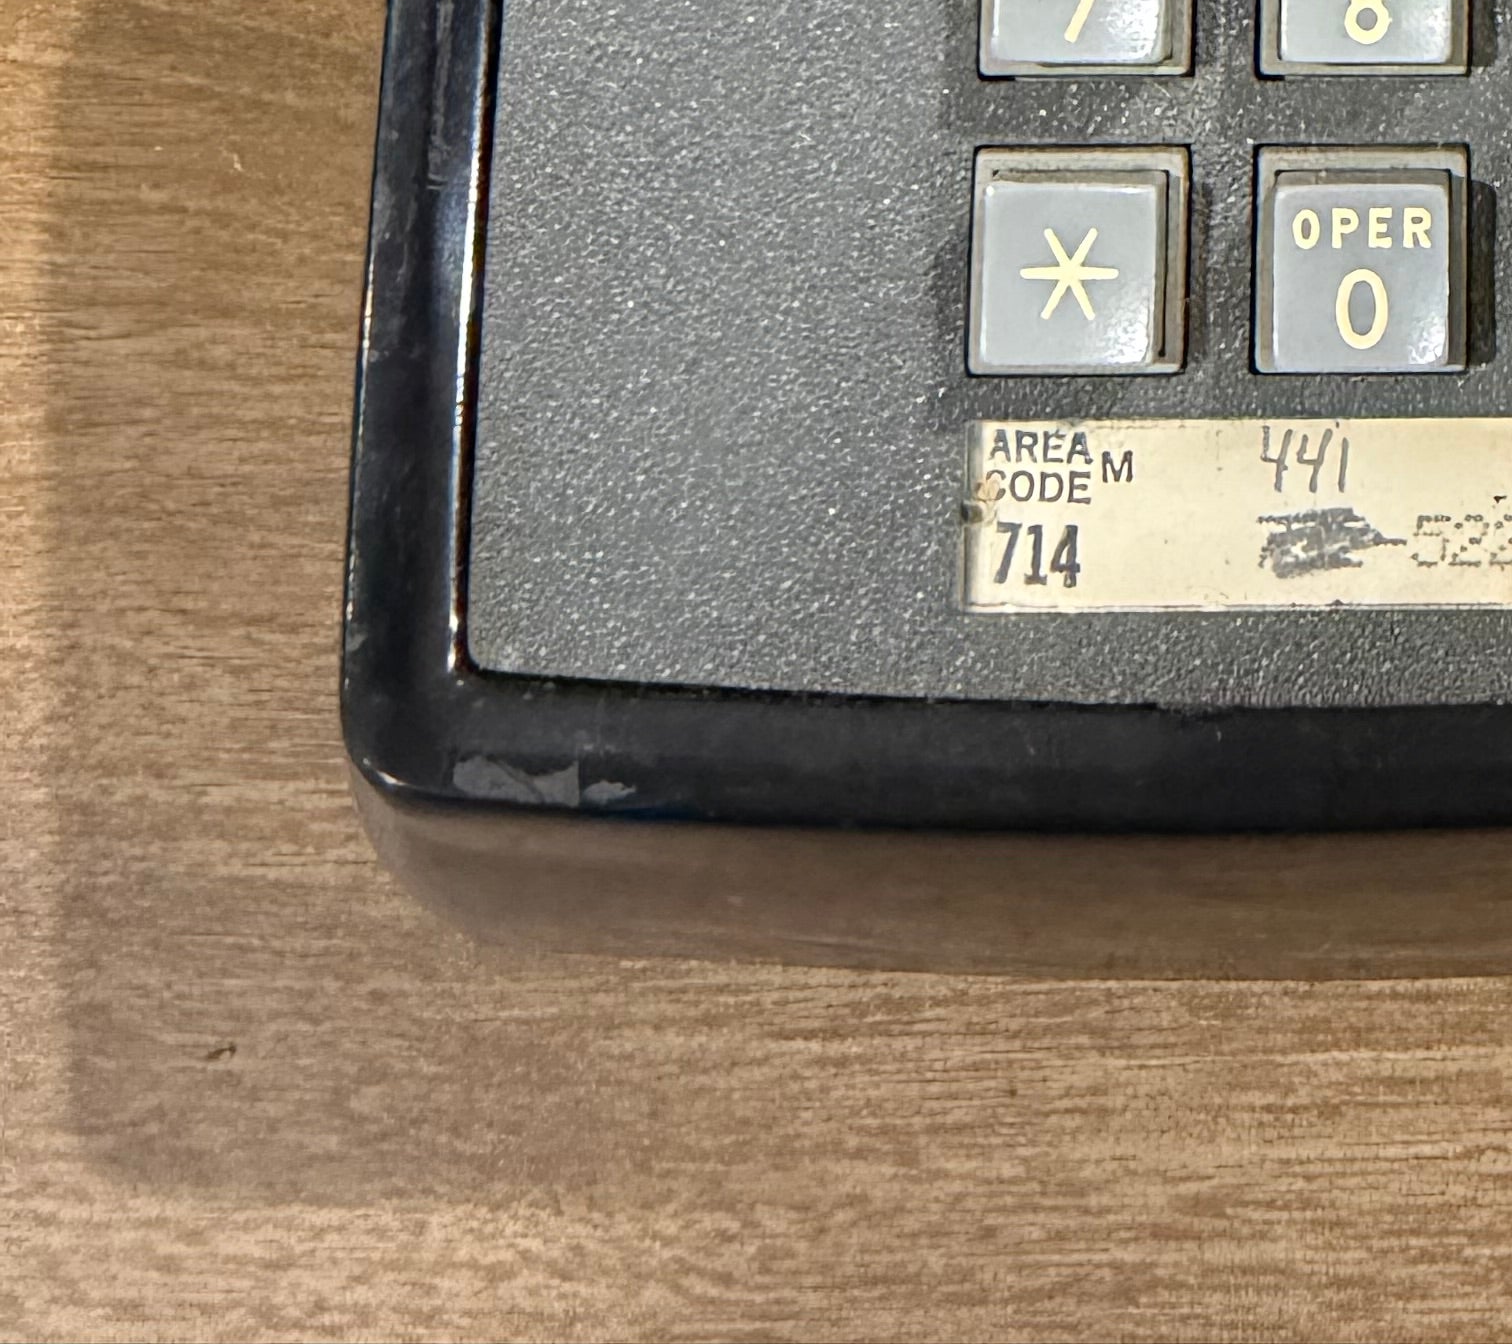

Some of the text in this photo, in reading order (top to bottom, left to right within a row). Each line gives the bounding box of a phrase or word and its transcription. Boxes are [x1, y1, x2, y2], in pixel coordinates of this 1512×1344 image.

[1292, 206, 1433, 251] OPER
[1334, 267, 1389, 350] 0
[989, 428, 1094, 465] AREA
[1101, 449, 1134, 484] M
[1260, 425, 1350, 494] 441
[985, 469, 1092, 505] CODE
[993, 520, 1081, 589] 714
